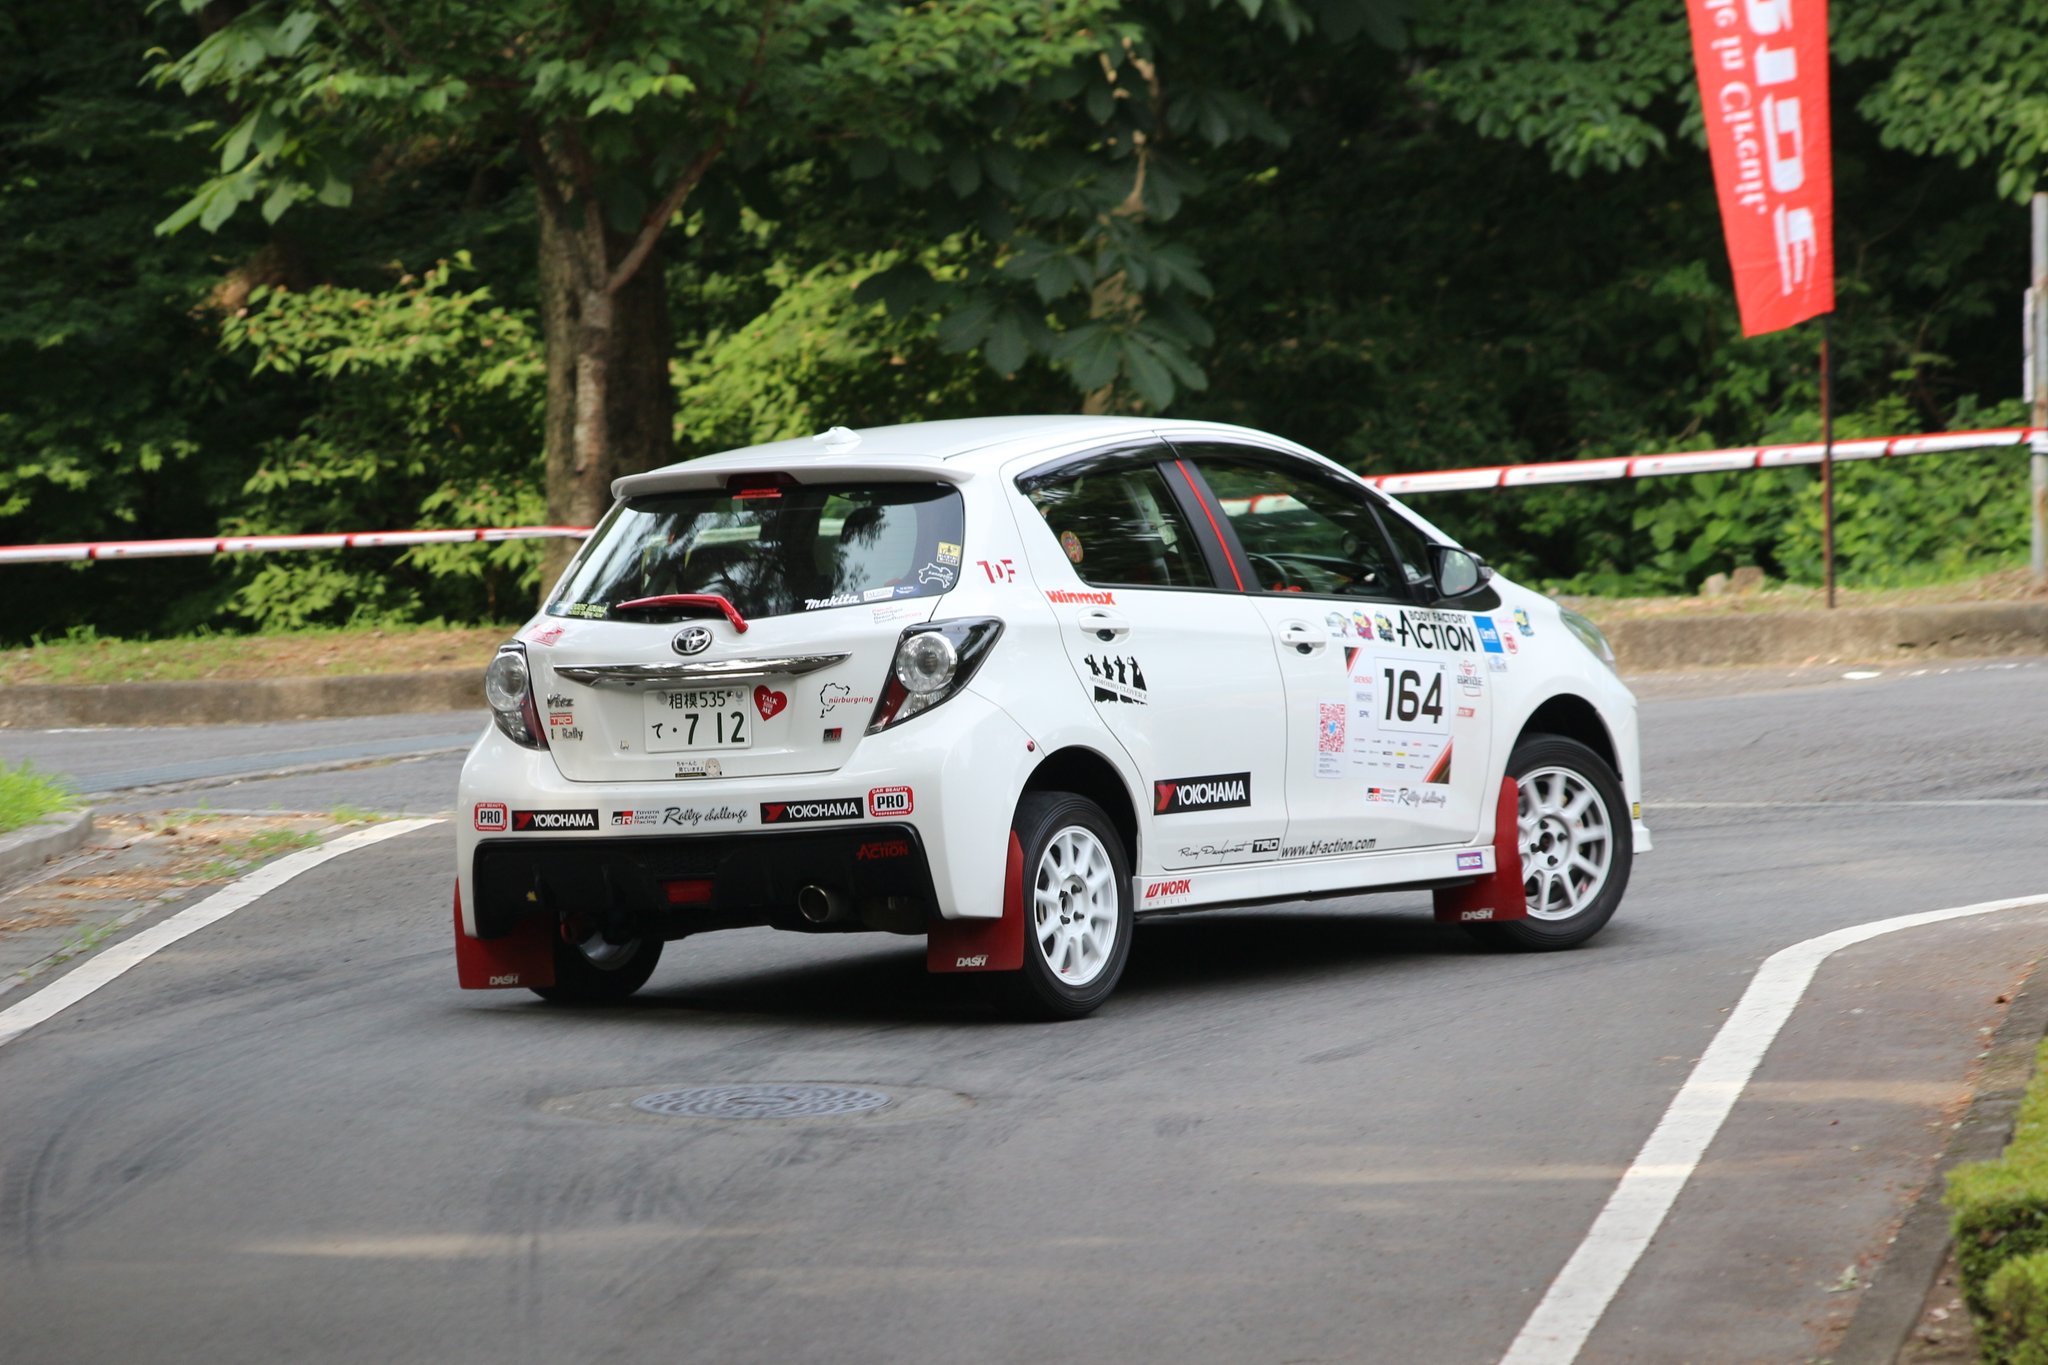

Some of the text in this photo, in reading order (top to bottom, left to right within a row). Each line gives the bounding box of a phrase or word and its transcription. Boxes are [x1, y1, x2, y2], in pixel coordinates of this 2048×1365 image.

[1408, 610, 1467, 624] BODY FACTORY
[1396, 609, 1476, 652] ACTION
[828, 695, 874, 705] nürburgring
[1383, 667, 1444, 724] 164
[562, 727, 584, 741] Rally
[651, 722, 664, 739] て
[1175, 779, 1247, 806] YOKOHAMA
[876, 793, 905, 809] PRO
[480, 810, 501, 824] PRO
[662, 806, 748, 827] Rally challenge
[786, 801, 859, 819] YOKOHAMA
[532, 813, 595, 828] YOKOHAMA
[1254, 838, 1279, 852] TRD
[1281, 838, 1377, 859] www.bf-action.com
[1160, 879, 1192, 896] WORK
[1461, 908, 1494, 921] DASH
[955, 955, 988, 967] DASH
